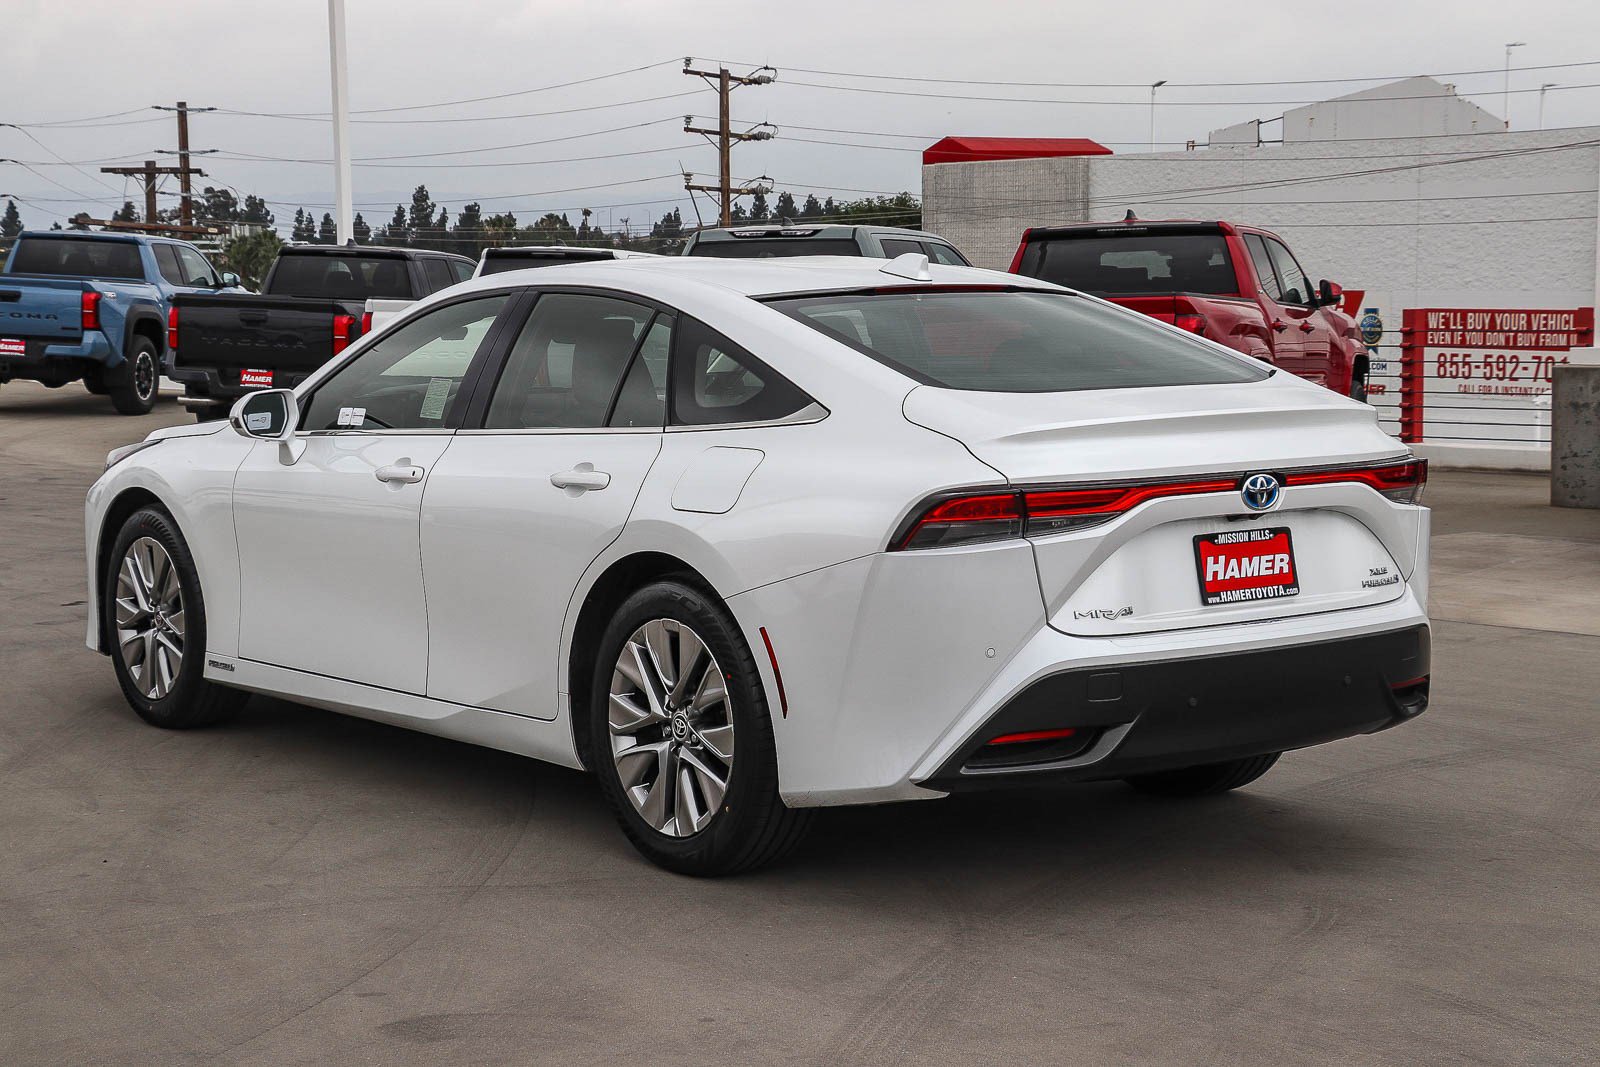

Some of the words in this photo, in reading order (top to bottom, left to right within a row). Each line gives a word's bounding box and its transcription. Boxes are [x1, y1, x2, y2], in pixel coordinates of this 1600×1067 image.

[0, 311, 58, 320] OMA
[1427, 312, 1464, 329] WE'LL
[1467, 312, 1491, 330] BUY
[1494, 313, 1527, 331] YOUR
[1530, 313, 1577, 331] VEHICL
[1427, 331, 1451, 345] EVEN
[1453, 332, 1463, 345] IF
[1465, 332, 1483, 345] YOU
[1486, 332, 1514, 347] DON'T
[1517, 333, 1537, 347] BUY
[1539, 333, 1567, 347] FROM
[241, 374, 273, 383] HAMER
[1218, 531, 1249, 544] MISSION
[1250, 530, 1270, 541] HILLS
[1206, 553, 1290, 582] HAMER
[1207, 585, 1299, 604] www.HAMERTOYOTA.com
